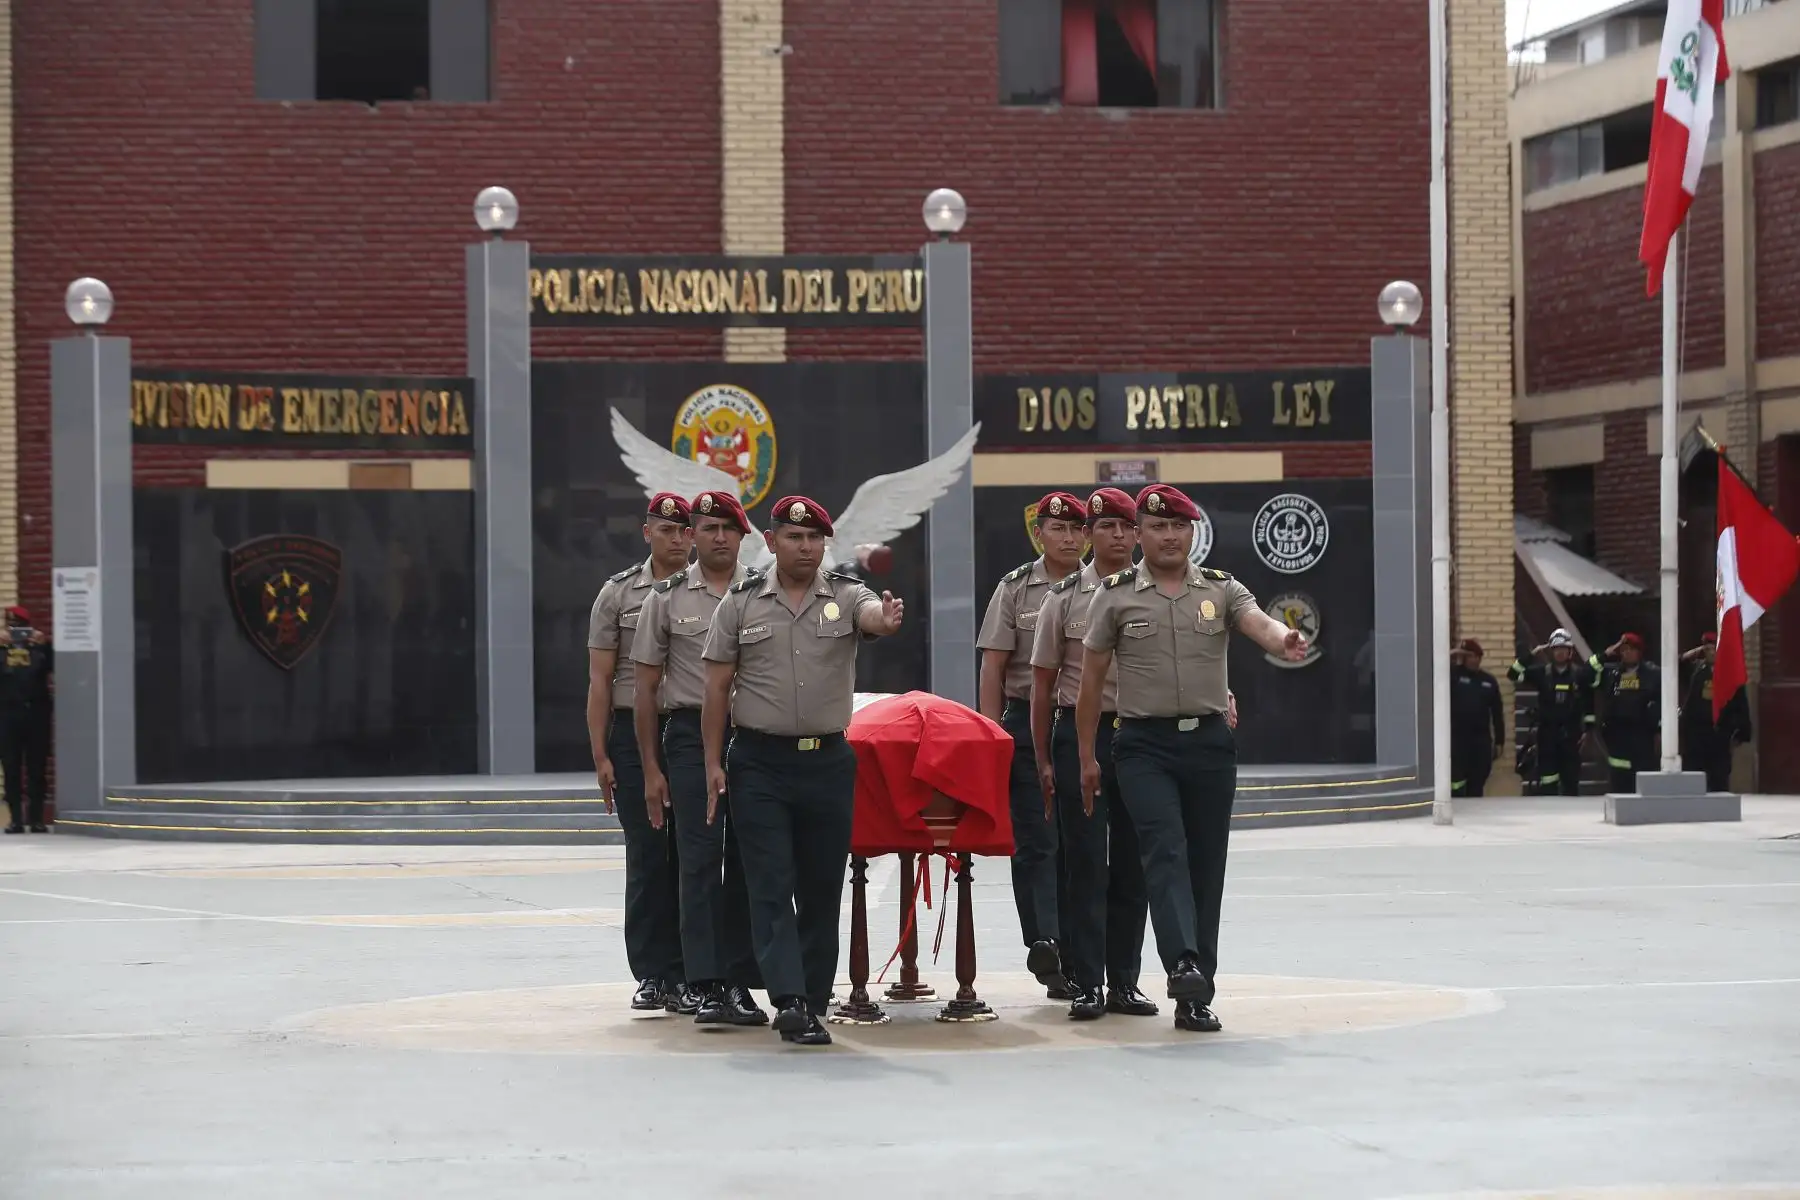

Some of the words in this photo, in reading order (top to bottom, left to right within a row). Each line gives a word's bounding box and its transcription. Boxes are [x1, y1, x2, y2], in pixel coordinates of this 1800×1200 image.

[528, 268, 634, 315] POLICIA
[638, 268, 777, 315] NACIONAL
[782, 269, 841, 313] DEL
[846, 268, 923, 314] PERU
[130, 379, 231, 430] IVISION
[237, 384, 275, 432] DE
[281, 388, 470, 435] EMERGENCIA
[1017, 386, 1096, 431] DIOS
[1124, 383, 1242, 430] PATRIA
[1272, 379, 1335, 427] LEY
[1266, 552, 1314, 569] EXPLOSIVOS
[1277, 541, 1303, 553] UDEX
